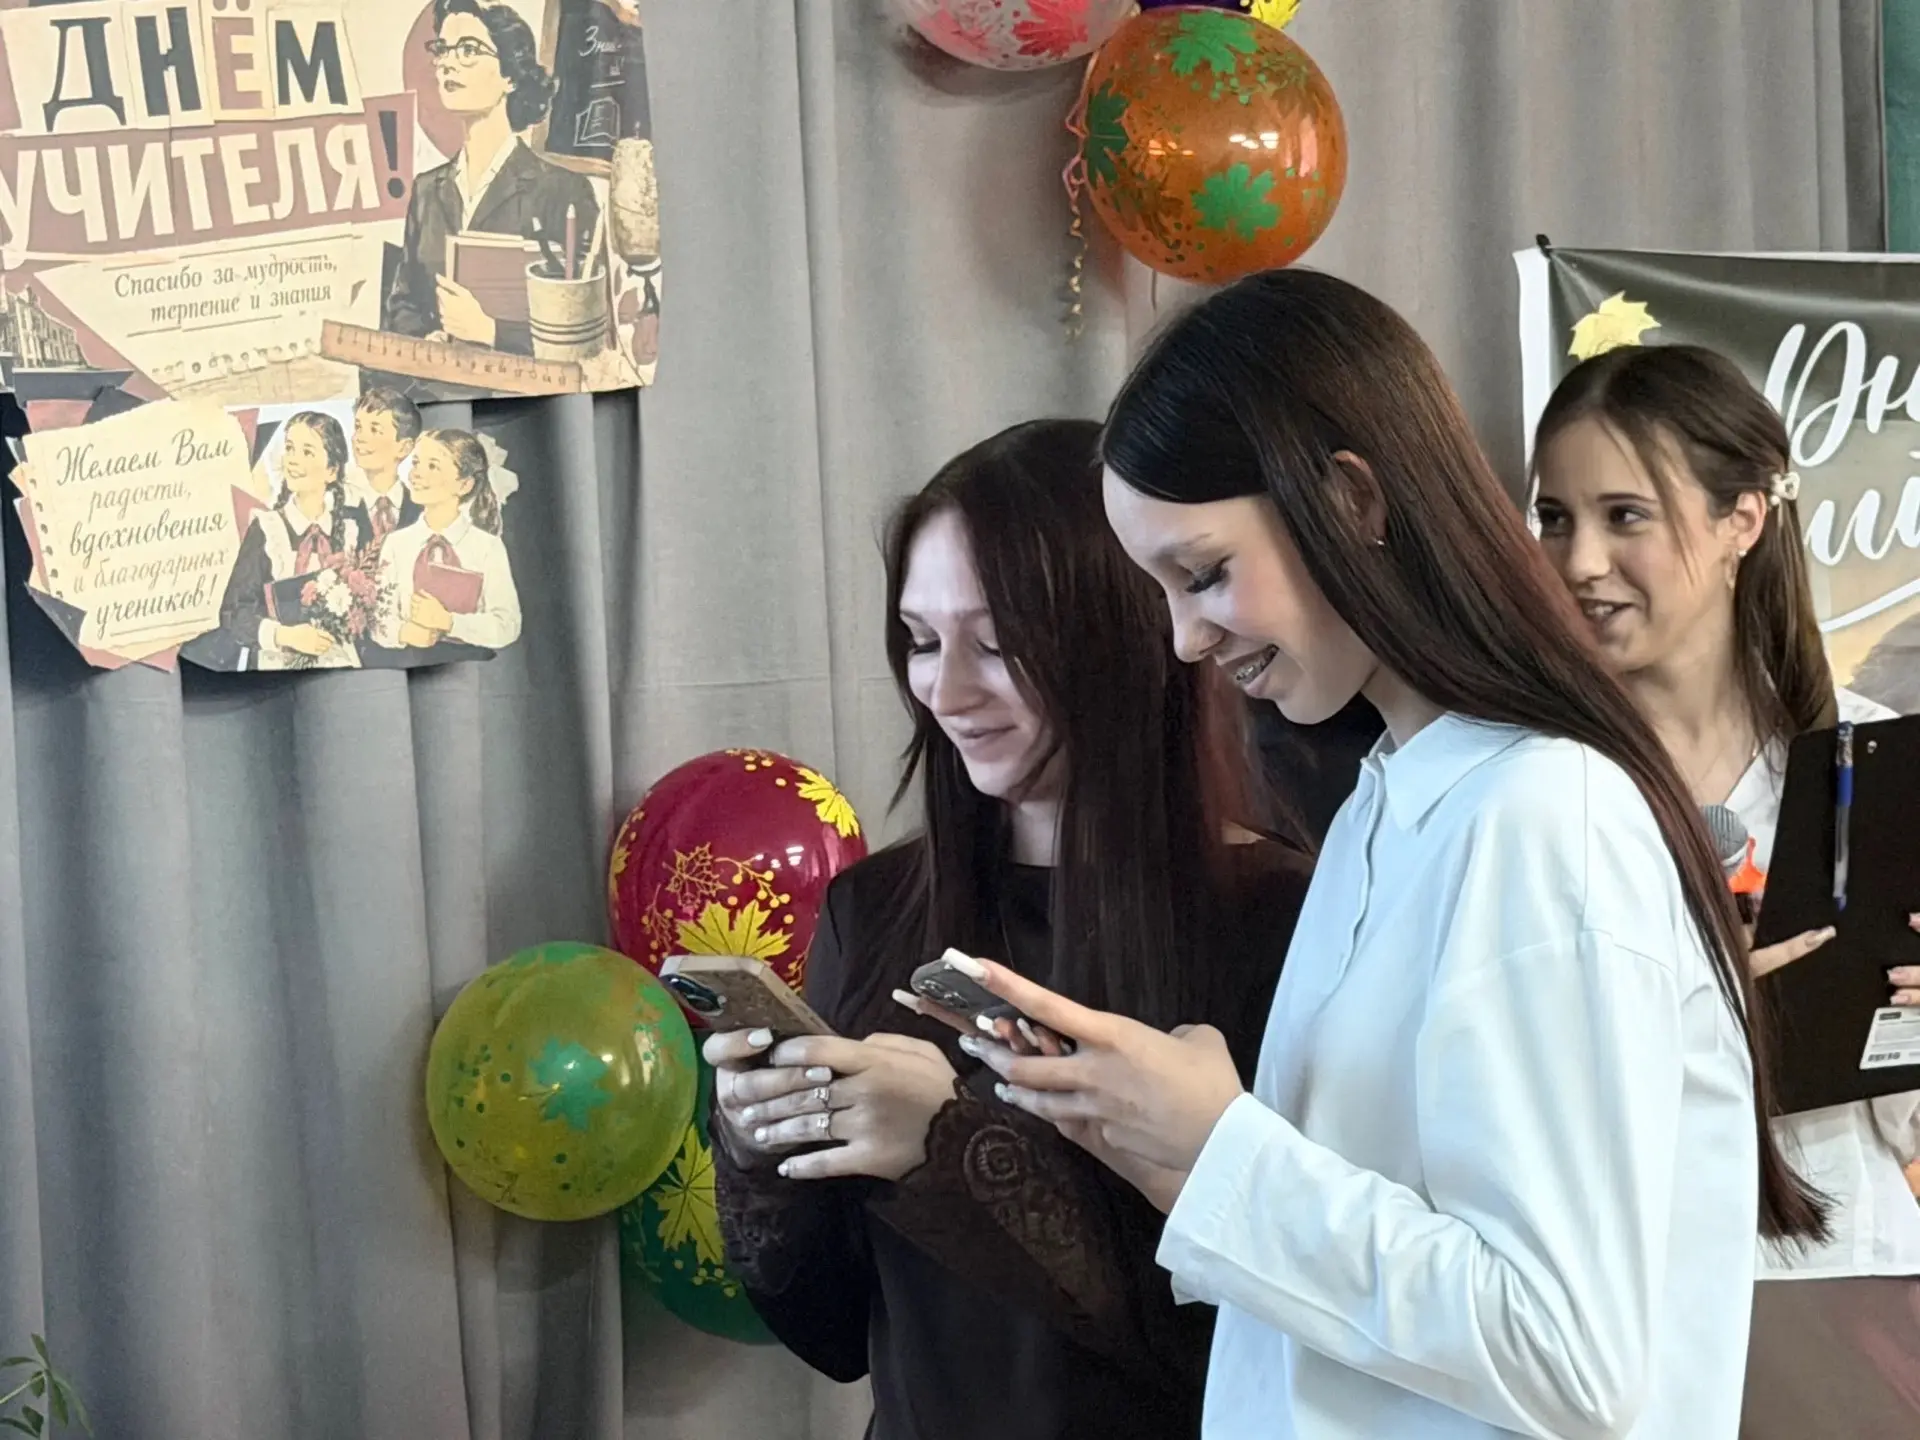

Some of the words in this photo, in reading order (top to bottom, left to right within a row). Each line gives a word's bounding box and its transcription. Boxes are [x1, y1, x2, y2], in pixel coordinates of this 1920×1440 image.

[42, 0, 349, 132] ДНЁМ
[0, 110, 405, 270] УЧИТЕЛЯ!
[114, 264, 203, 298] Спасибо
[213, 266, 236, 285] за
[150, 294, 241, 324] терпение
[250, 292, 261, 311] и
[269, 284, 332, 307] знания
[56, 443, 162, 487] Желаем
[171, 428, 234, 467] Вам
[87, 480, 192, 525] радости,
[69, 508, 229, 570] вдохновения
[73, 575, 85, 595] и
[96, 573, 218, 641] учеников!
